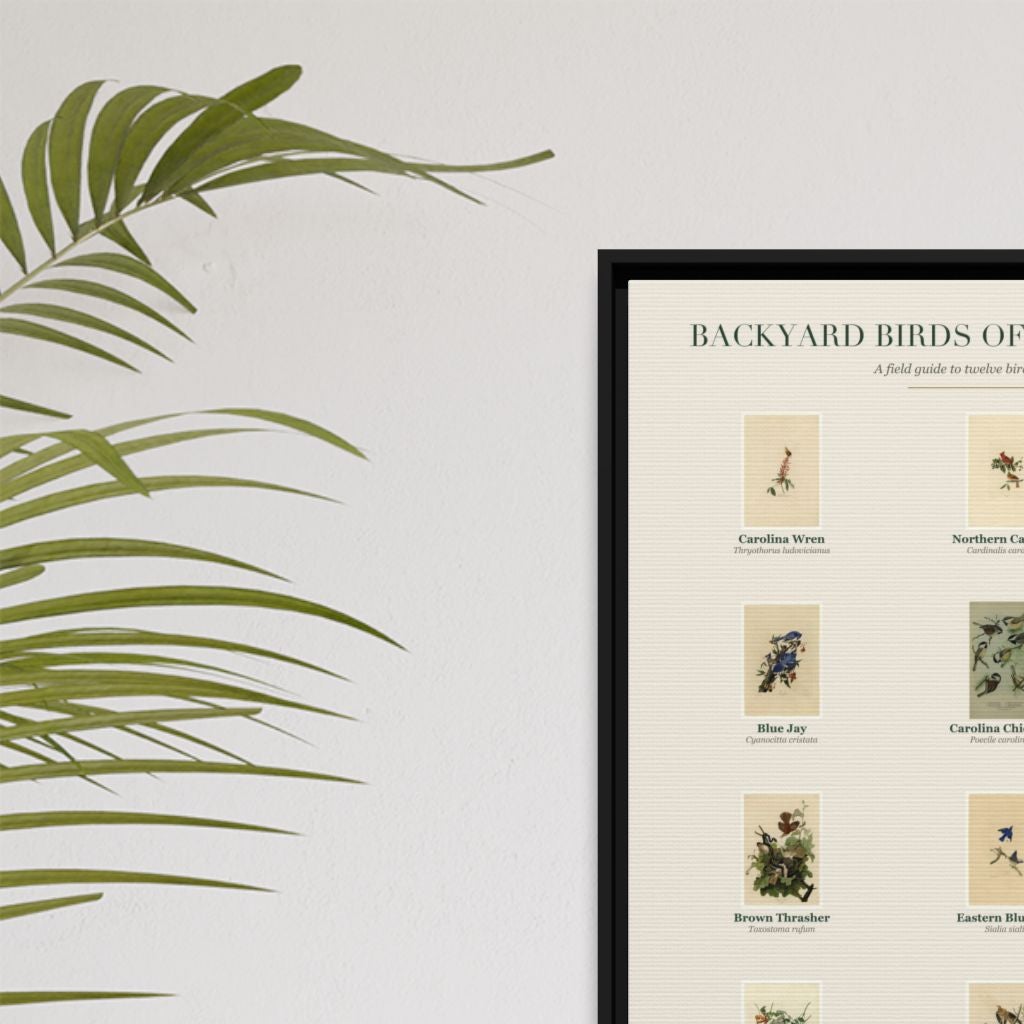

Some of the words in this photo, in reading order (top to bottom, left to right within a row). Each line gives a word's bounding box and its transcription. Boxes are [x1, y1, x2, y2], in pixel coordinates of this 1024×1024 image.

[689, 323, 865, 347] BACKYARD
[875, 323, 971, 347] BIRDS
[982, 324, 1024, 348] OF
[873, 364, 883, 374] A
[884, 363, 912, 377] field
[914, 363, 947, 377] guide
[950, 365, 962, 374] to
[964, 363, 1003, 374] twelve
[738, 534, 789, 544] Carolina
[792, 534, 825, 544] Wren
[952, 534, 1007, 544] Northern
[733, 546, 780, 556] Thryothorus
[782, 546, 830, 554] ludovicianus
[757, 723, 784, 733] Blue
[787, 724, 807, 735] Jay
[949, 723, 1000, 733] Carolina
[745, 736, 787, 745] Cyanocitta
[788, 736, 818, 744] cristata
[970, 736, 997, 744] Poecile
[734, 913, 773, 922] Brown
[776, 913, 830, 922] Thrasher
[957, 913, 1002, 922] Eastern
[792, 926, 815, 934] rufum
